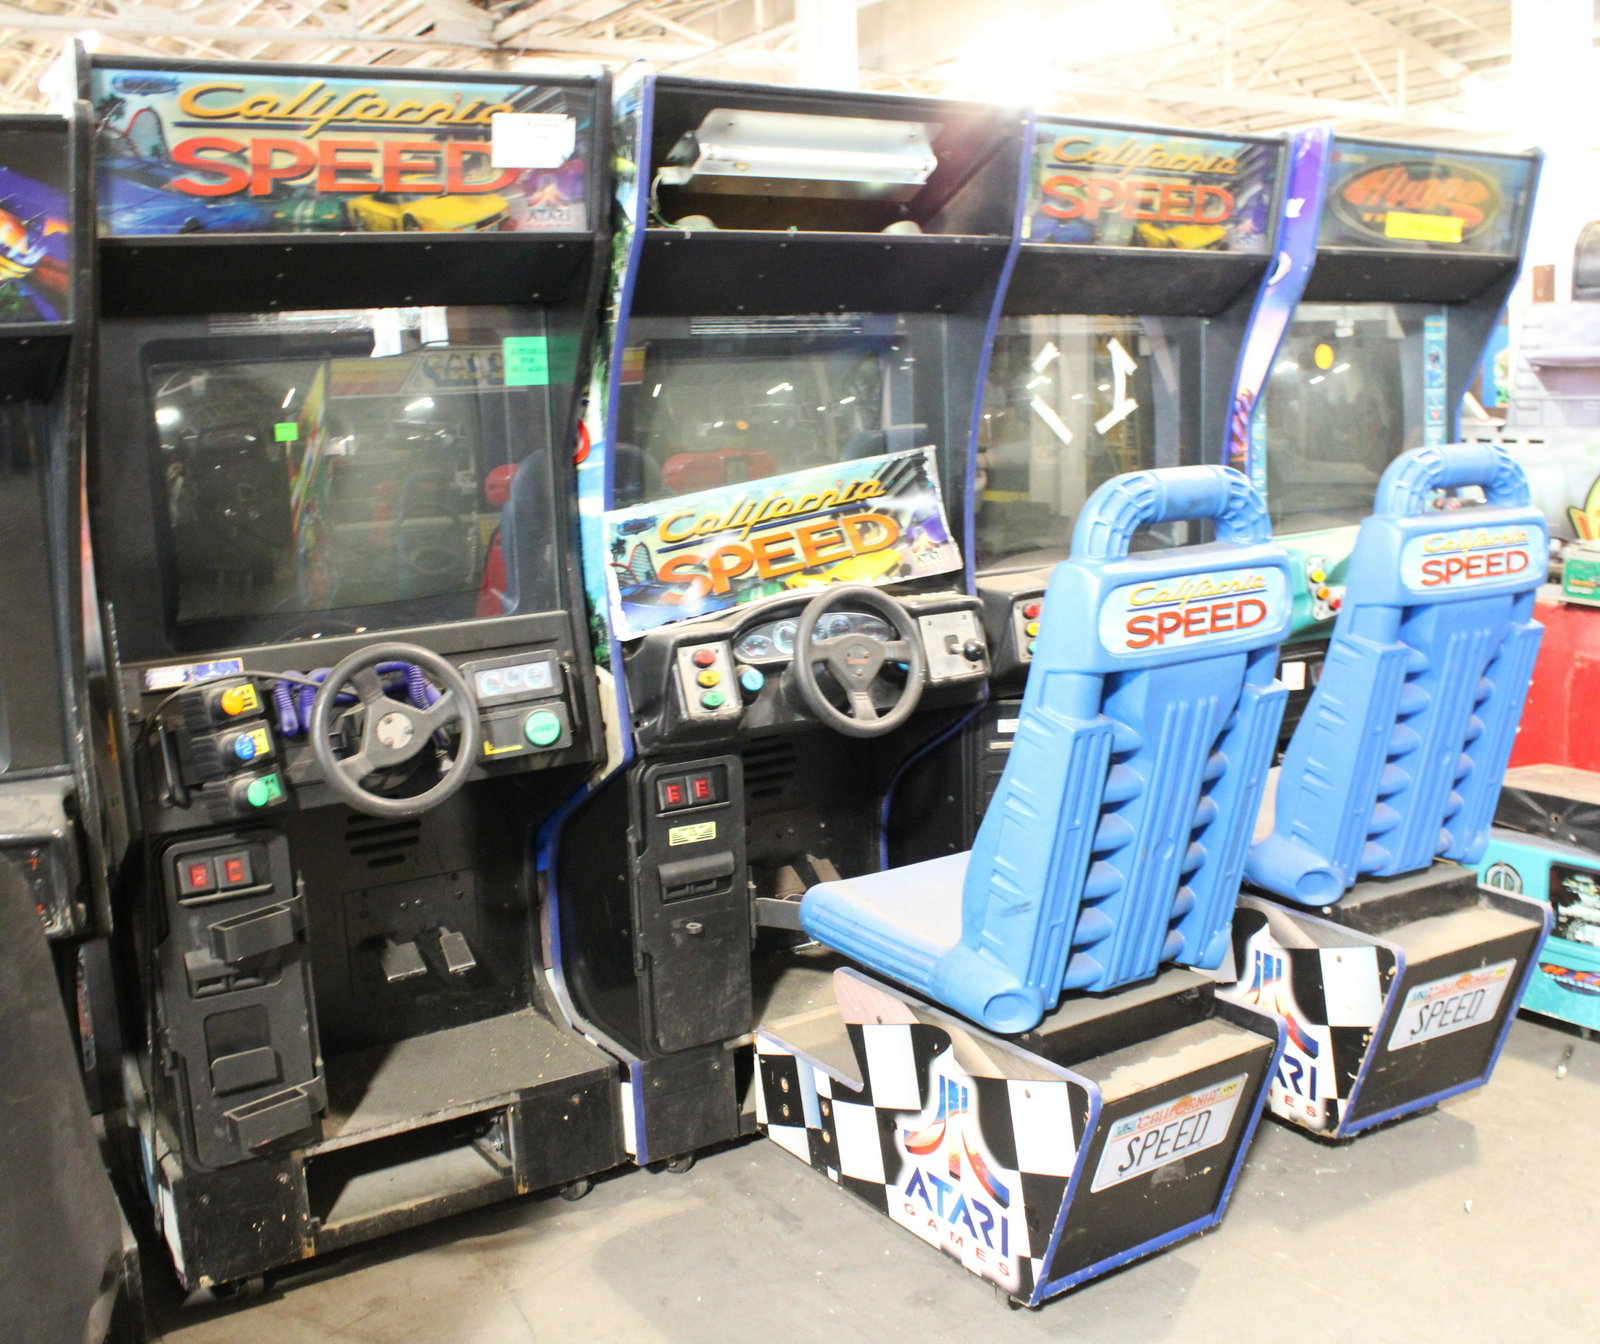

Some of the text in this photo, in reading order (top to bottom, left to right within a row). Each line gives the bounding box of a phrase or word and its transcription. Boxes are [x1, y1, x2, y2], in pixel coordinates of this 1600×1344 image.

[170, 136, 522, 196] SPEED
[1052, 137, 1239, 179] California
[1040, 174, 1235, 224] SPEED
[657, 479, 887, 541] California
[656, 513, 899, 605] SPEED
[1423, 526, 1529, 554] California
[1128, 574, 1267, 608] California
[1420, 550, 1529, 587] SPEED
[1125, 598, 1267, 649] SPEED
[1410, 988, 1485, 1036] SPEED
[1117, 1109, 1212, 1173] SPEED
[904, 1166, 1009, 1259] ATARI
[904, 1203, 1010, 1277] GAMES
